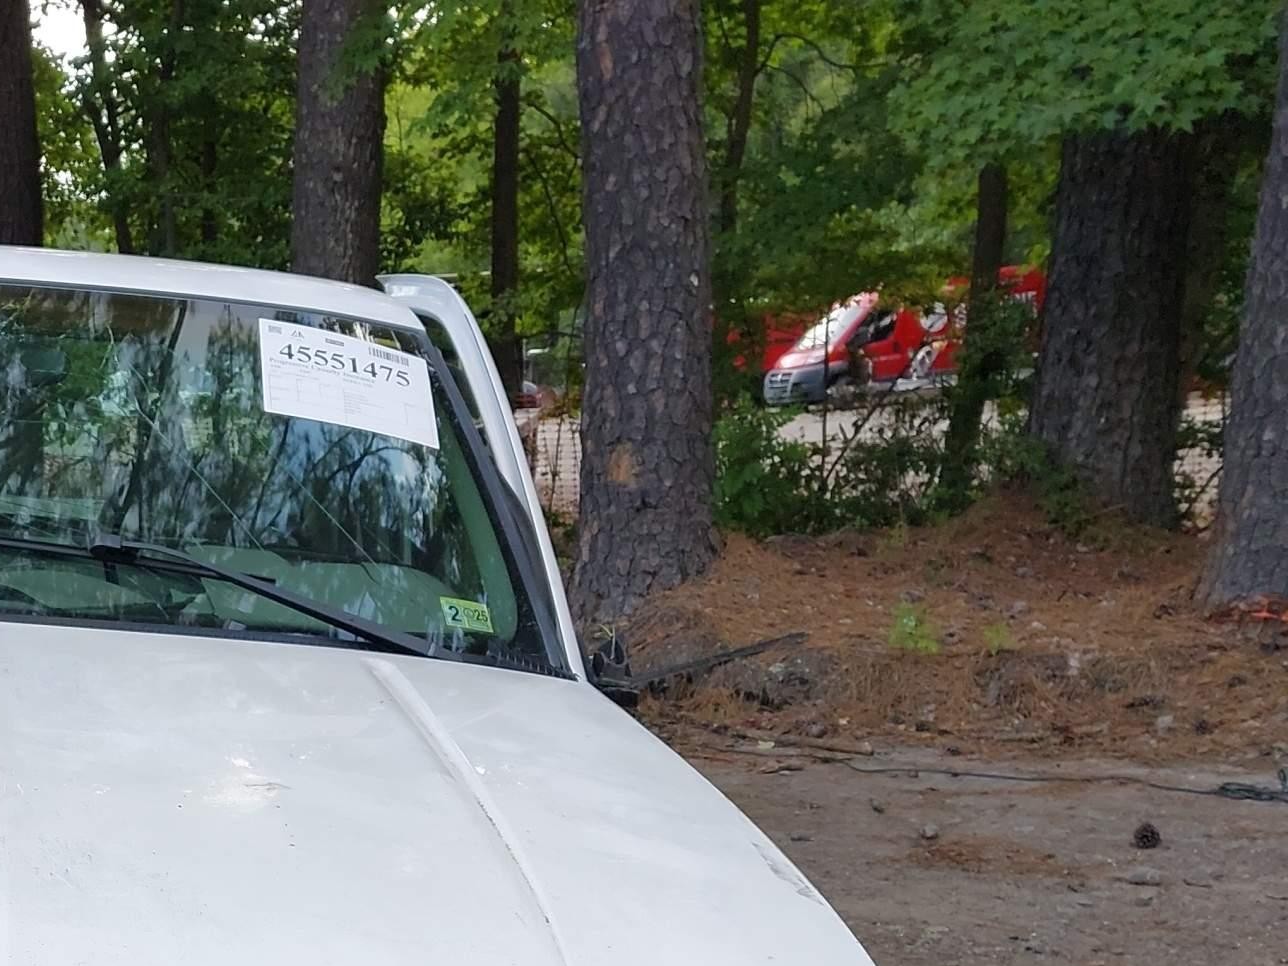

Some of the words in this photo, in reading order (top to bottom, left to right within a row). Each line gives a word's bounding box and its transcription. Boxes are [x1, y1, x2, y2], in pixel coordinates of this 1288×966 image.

[279, 343, 410, 387] 45551475
[448, 605, 462, 622] 2
[473, 609, 488, 622] 25
